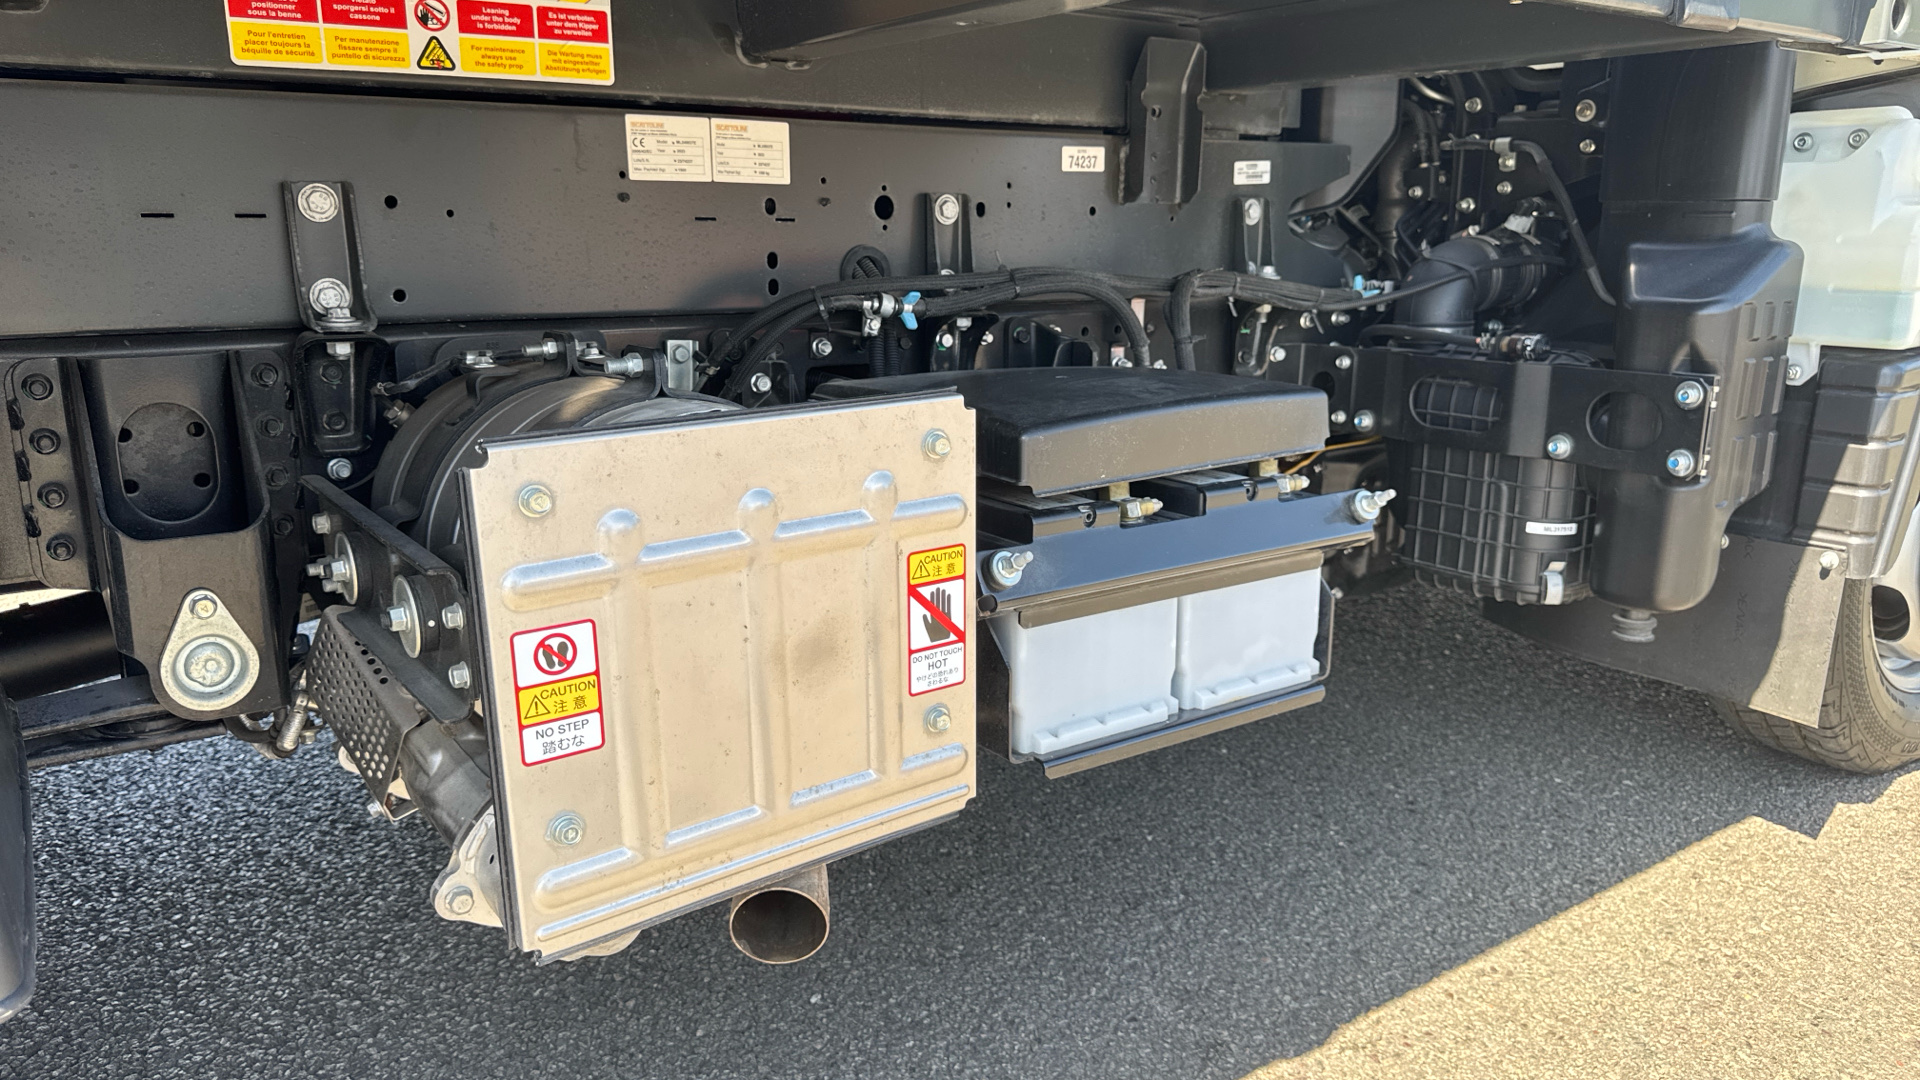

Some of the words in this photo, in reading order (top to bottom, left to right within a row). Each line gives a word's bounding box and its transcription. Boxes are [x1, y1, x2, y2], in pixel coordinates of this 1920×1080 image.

[251, 2, 296, 10] positionner
[332, 4, 369, 12] sporgersi
[277, 10, 302, 18] benne
[349, 13, 380, 21] cassone
[482, 7, 509, 17] Leaning
[504, 16, 521, 25] body
[485, 23, 516, 31] forbidden
[578, 22, 599, 30] Kipper
[244, 39, 268, 47] placer
[269, 41, 302, 49] toujours
[349, 36, 400, 46] manutenzione
[241, 47, 272, 56] béquille
[285, 48, 315, 57] sécurité
[338, 44, 363, 52] fissare
[364, 46, 391, 54] sempre
[331, 52, 361, 60] puntello
[372, 54, 405, 62] sicurezza
[559, 51, 584, 60] Wartung
[487, 61, 507, 70] safety
[564, 59, 600, 67] eingestellter
[545, 65, 580, 73] Abstützung
[582, 67, 606, 75] erfolgen
[1068, 155, 1098, 169] 74237
[924, 549, 963, 565] CAUTION
[932, 563, 956, 577] 注意
[913, 655, 923, 663] DO
[924, 651, 938, 661] NOT
[940, 646, 963, 658] TOUCH
[928, 658, 948, 671] HOT
[927, 677, 948, 687] さわるな
[540, 679, 596, 700] CAUTION
[553, 695, 588, 714] 注意
[536, 727, 554, 740] NO
[558, 719, 589, 734] STEP
[542, 734, 585, 755] 踏むな
